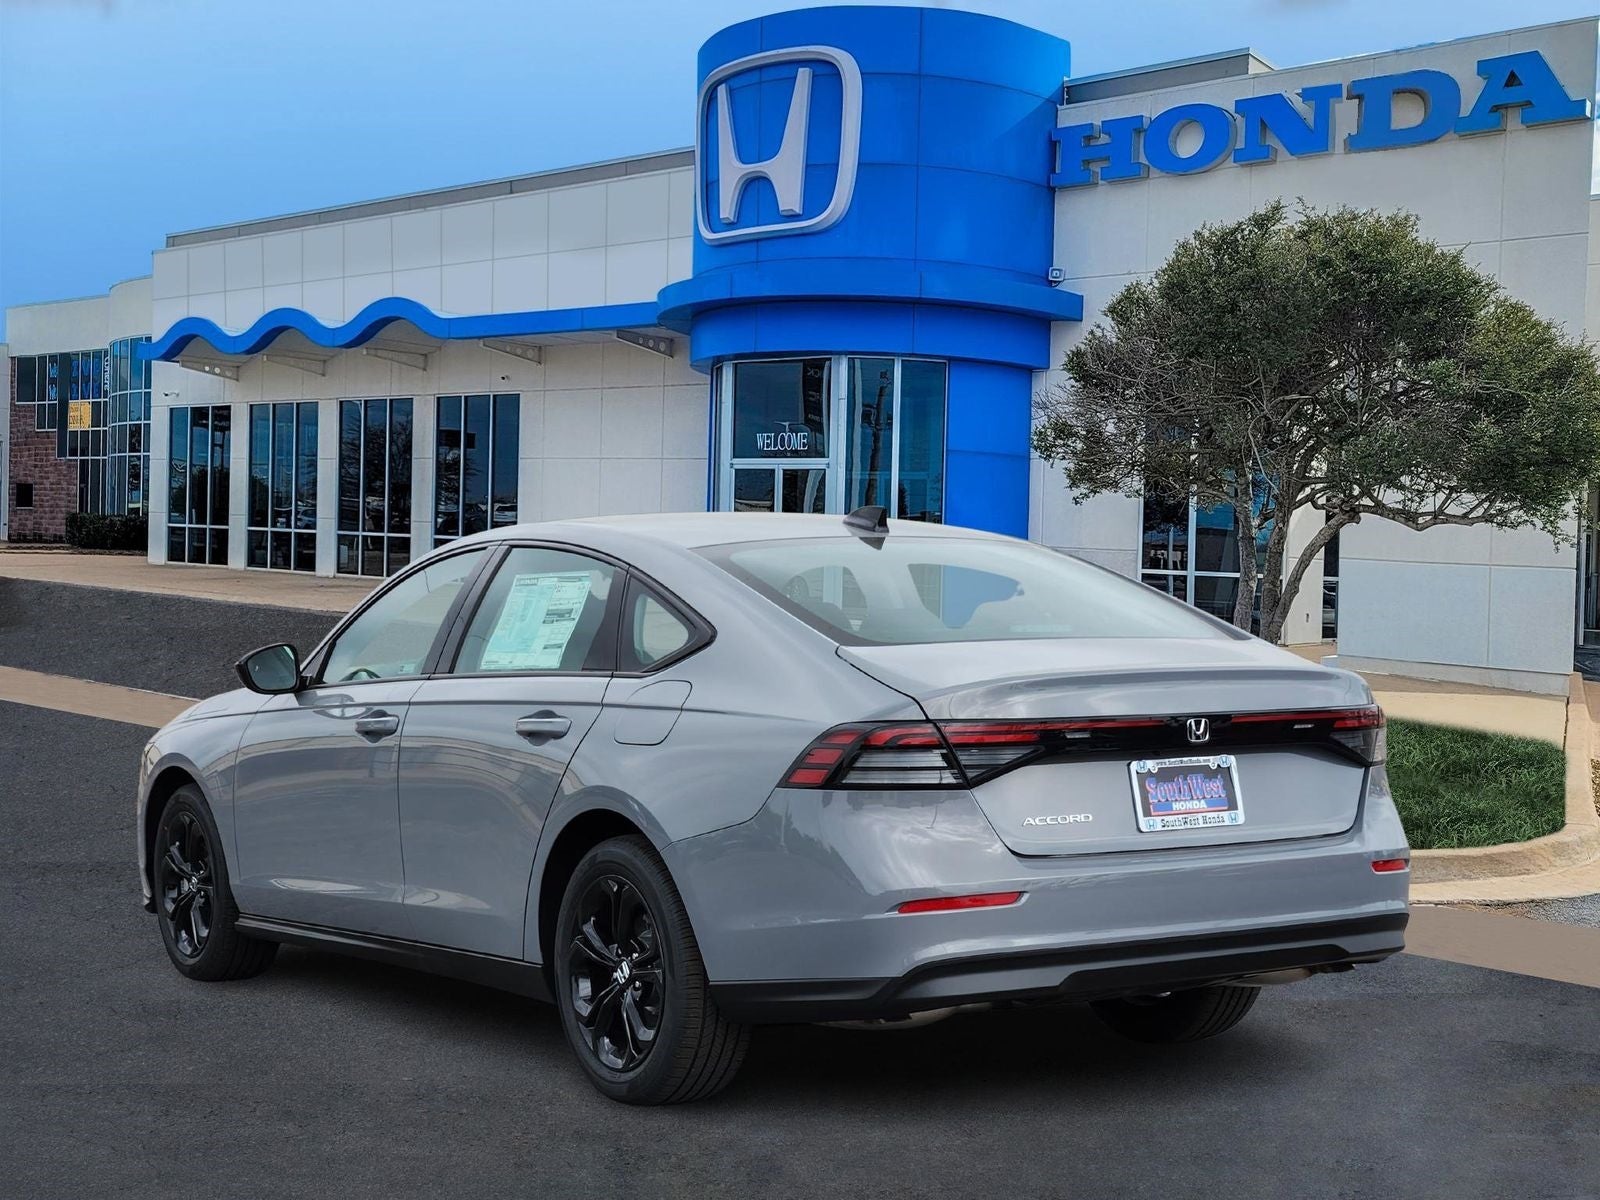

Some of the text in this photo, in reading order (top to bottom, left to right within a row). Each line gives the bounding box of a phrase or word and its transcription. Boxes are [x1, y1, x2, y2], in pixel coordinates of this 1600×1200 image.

[1051, 50, 1590, 188] HONDA
[756, 432, 809, 451] WELCOME
[1145, 773, 1226, 803] SouthWest
[1172, 799, 1207, 811] HONDA
[1022, 813, 1093, 826] ACCORD
[1160, 814, 1226, 828] SouthWest Honda
